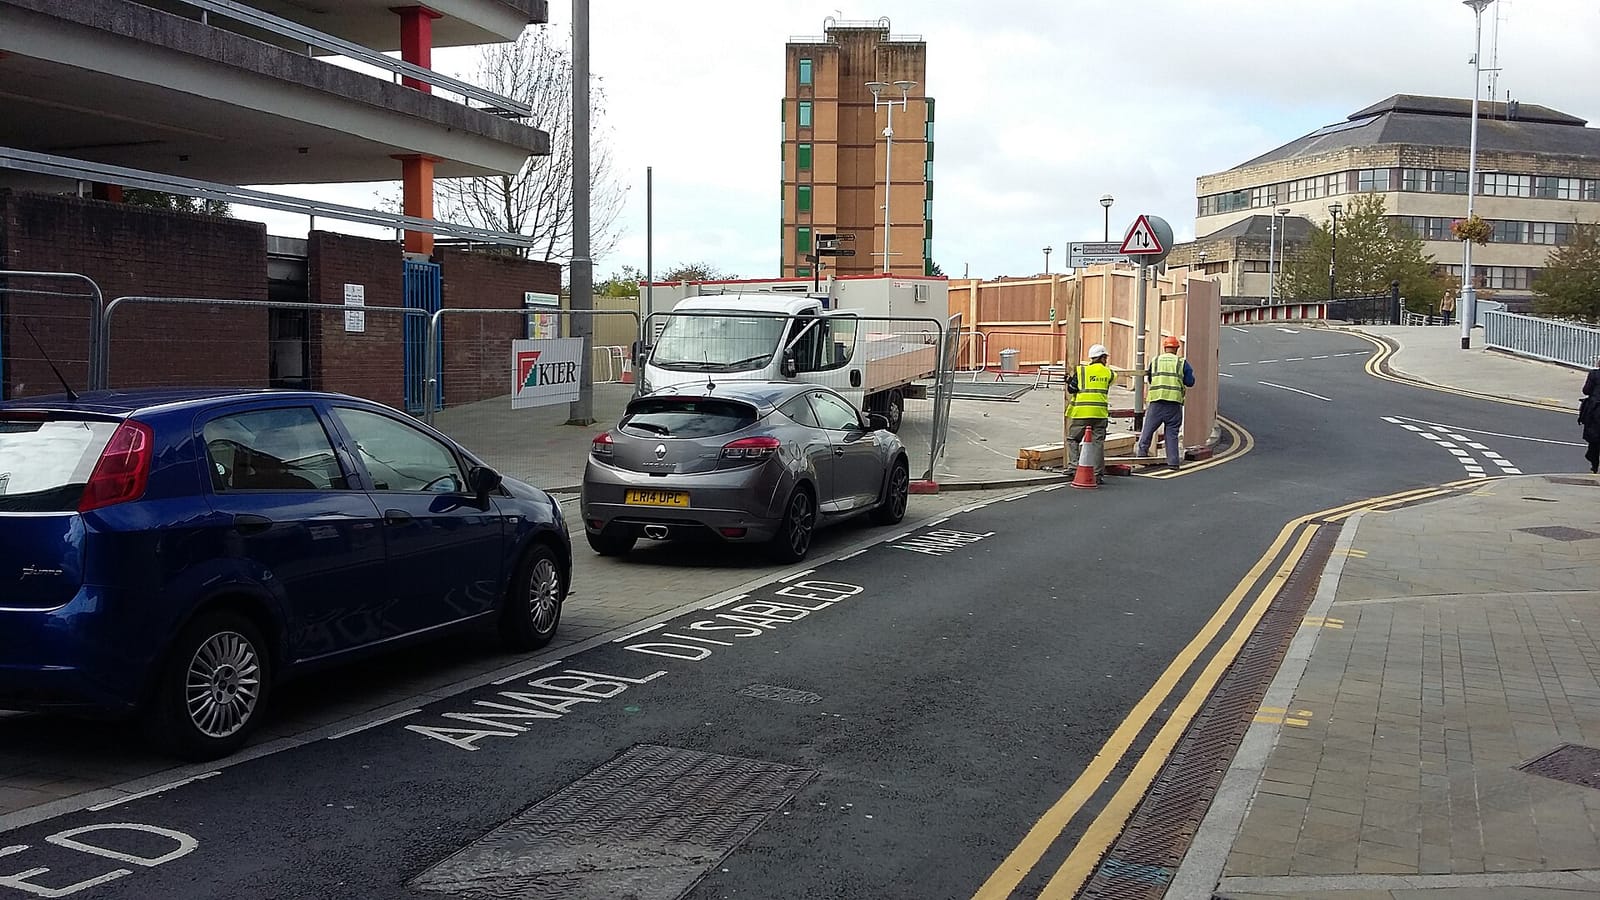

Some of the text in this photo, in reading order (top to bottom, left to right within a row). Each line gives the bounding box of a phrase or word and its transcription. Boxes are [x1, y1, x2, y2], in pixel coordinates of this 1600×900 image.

[539, 361, 577, 386] KIER
[632, 491, 681, 504] LR14 UPC
[884, 528, 996, 556] ANABL
[623, 580, 865, 661] DISABLED
[404, 669, 668, 751] ANABL
